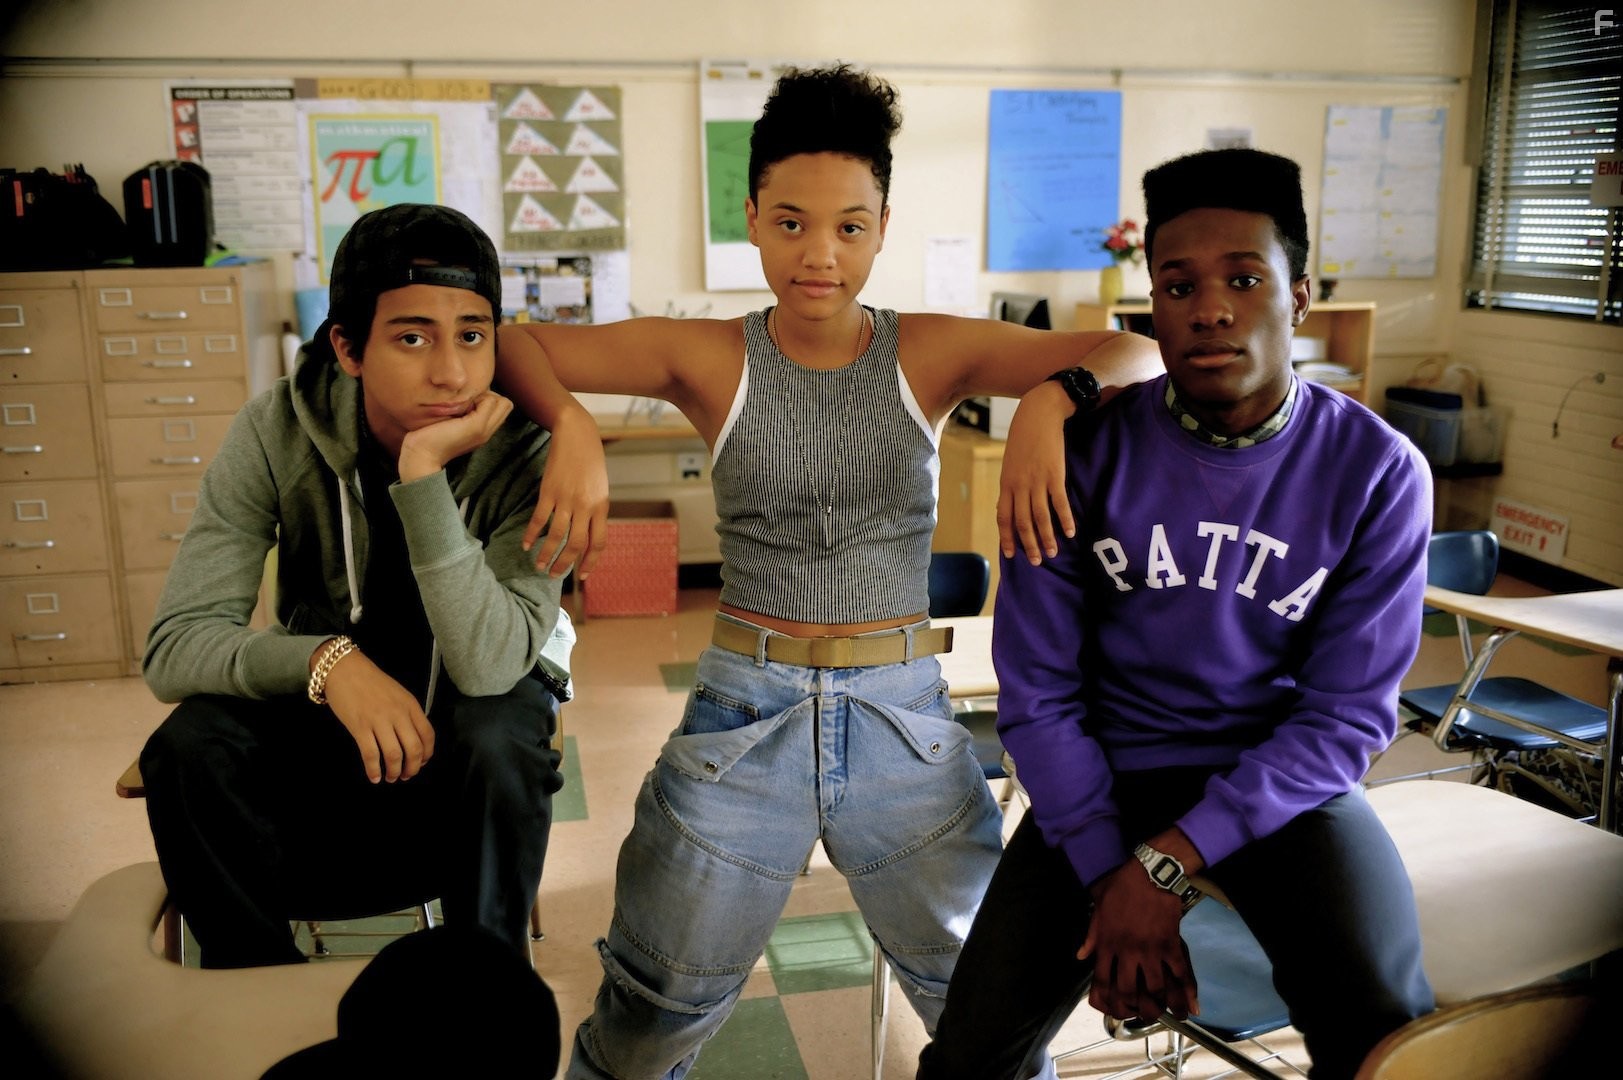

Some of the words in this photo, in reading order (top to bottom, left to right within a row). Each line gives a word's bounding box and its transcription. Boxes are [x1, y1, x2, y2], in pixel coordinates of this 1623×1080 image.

[174, 89, 210, 99] ORDER
[211, 89, 225, 99] OF
[226, 89, 291, 99] OPERATIONS
[1496, 503, 1565, 535] EMERGENCY
[1504, 524, 1536, 546] EXIT
[1093, 521, 1328, 622] PATTA
